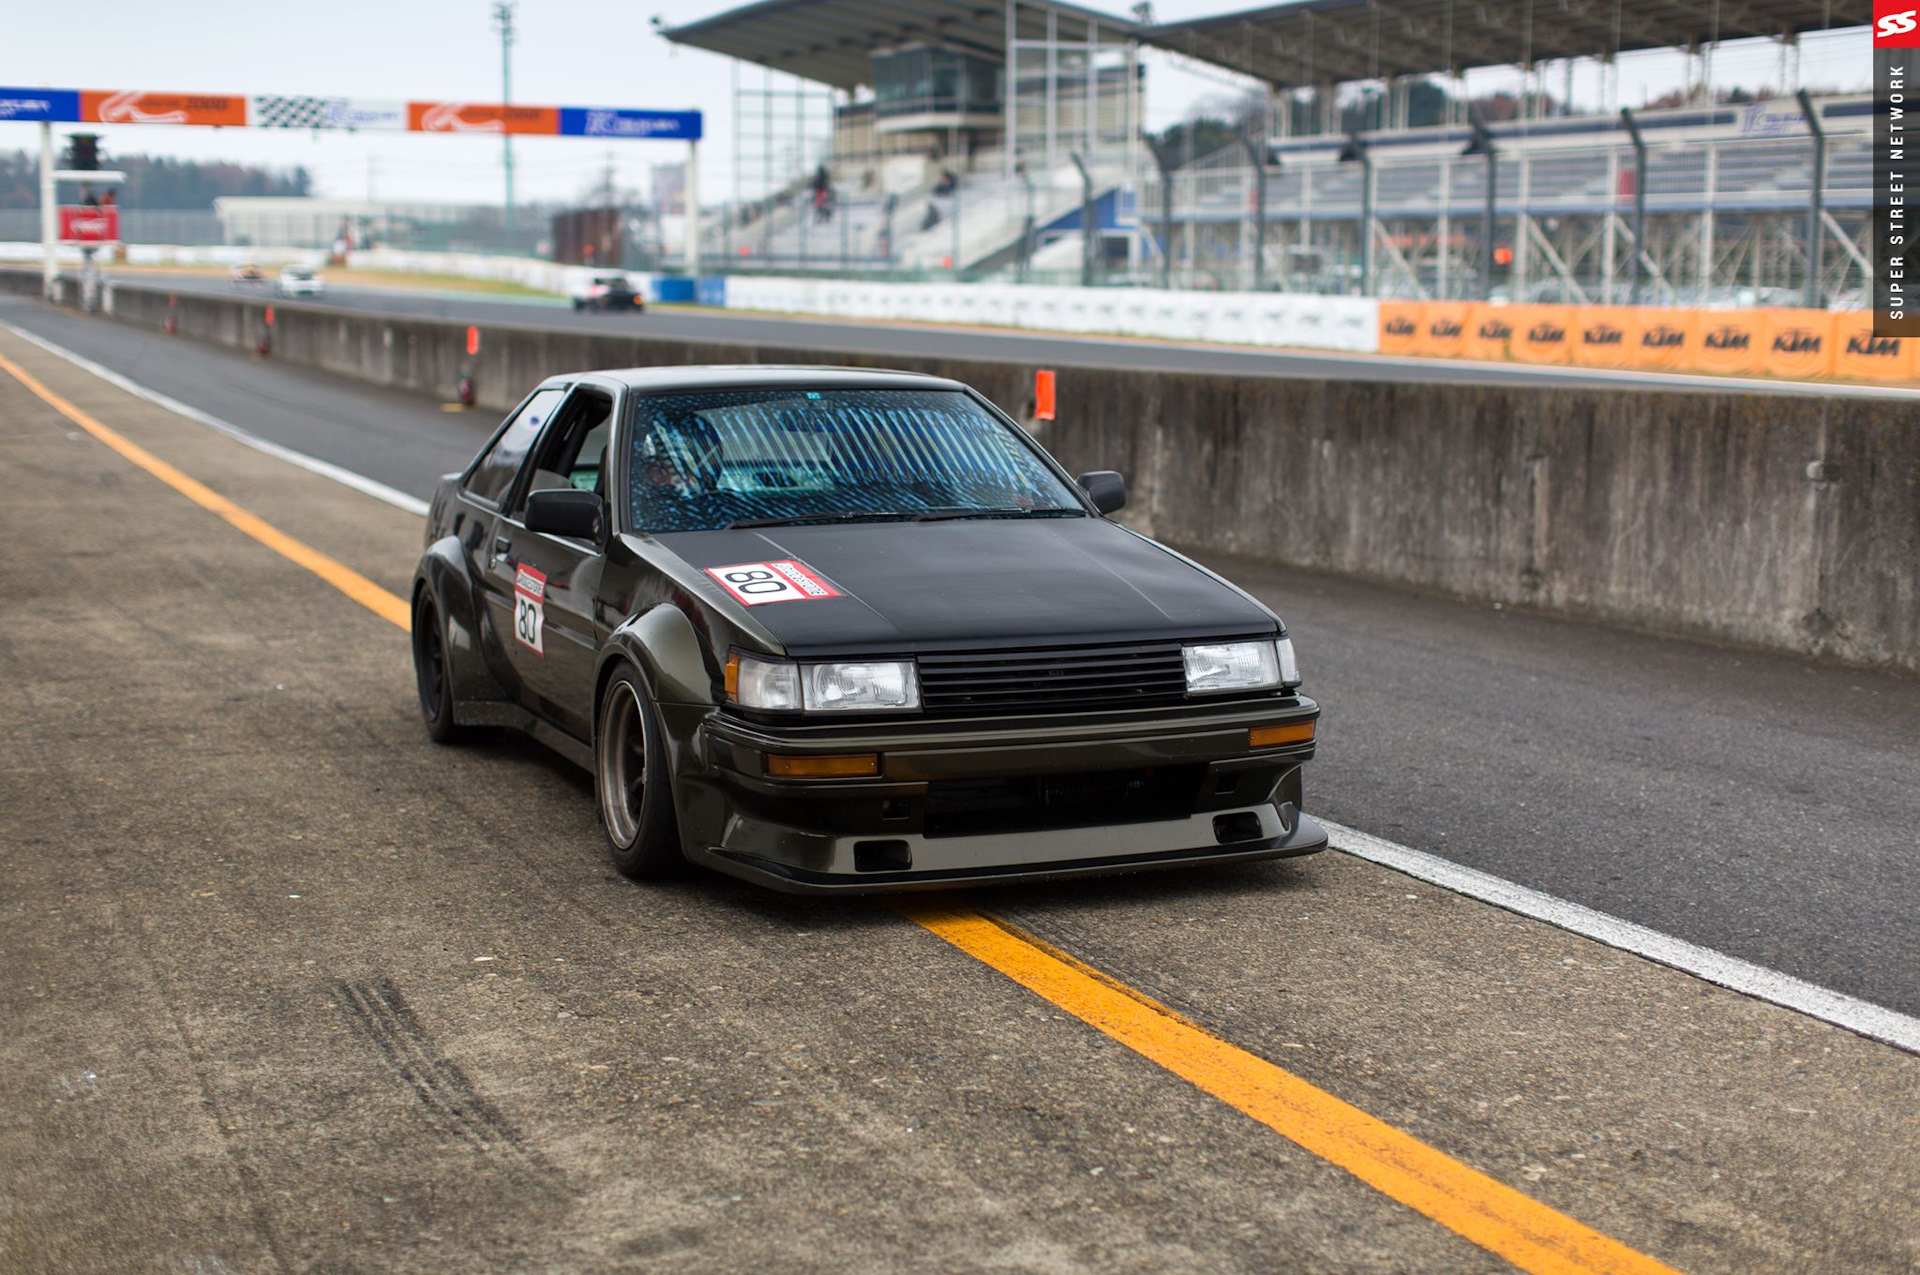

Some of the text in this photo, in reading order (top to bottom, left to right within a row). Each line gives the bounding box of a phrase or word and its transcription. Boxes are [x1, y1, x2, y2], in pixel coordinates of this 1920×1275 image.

[1642, 325, 1684, 347] KTM
[1705, 327, 1750, 349] KTM
[1772, 329, 1822, 353] KTM
[1846, 330, 1901, 356] KTM
[725, 570, 787, 594] 80
[519, 598, 536, 644] 80
